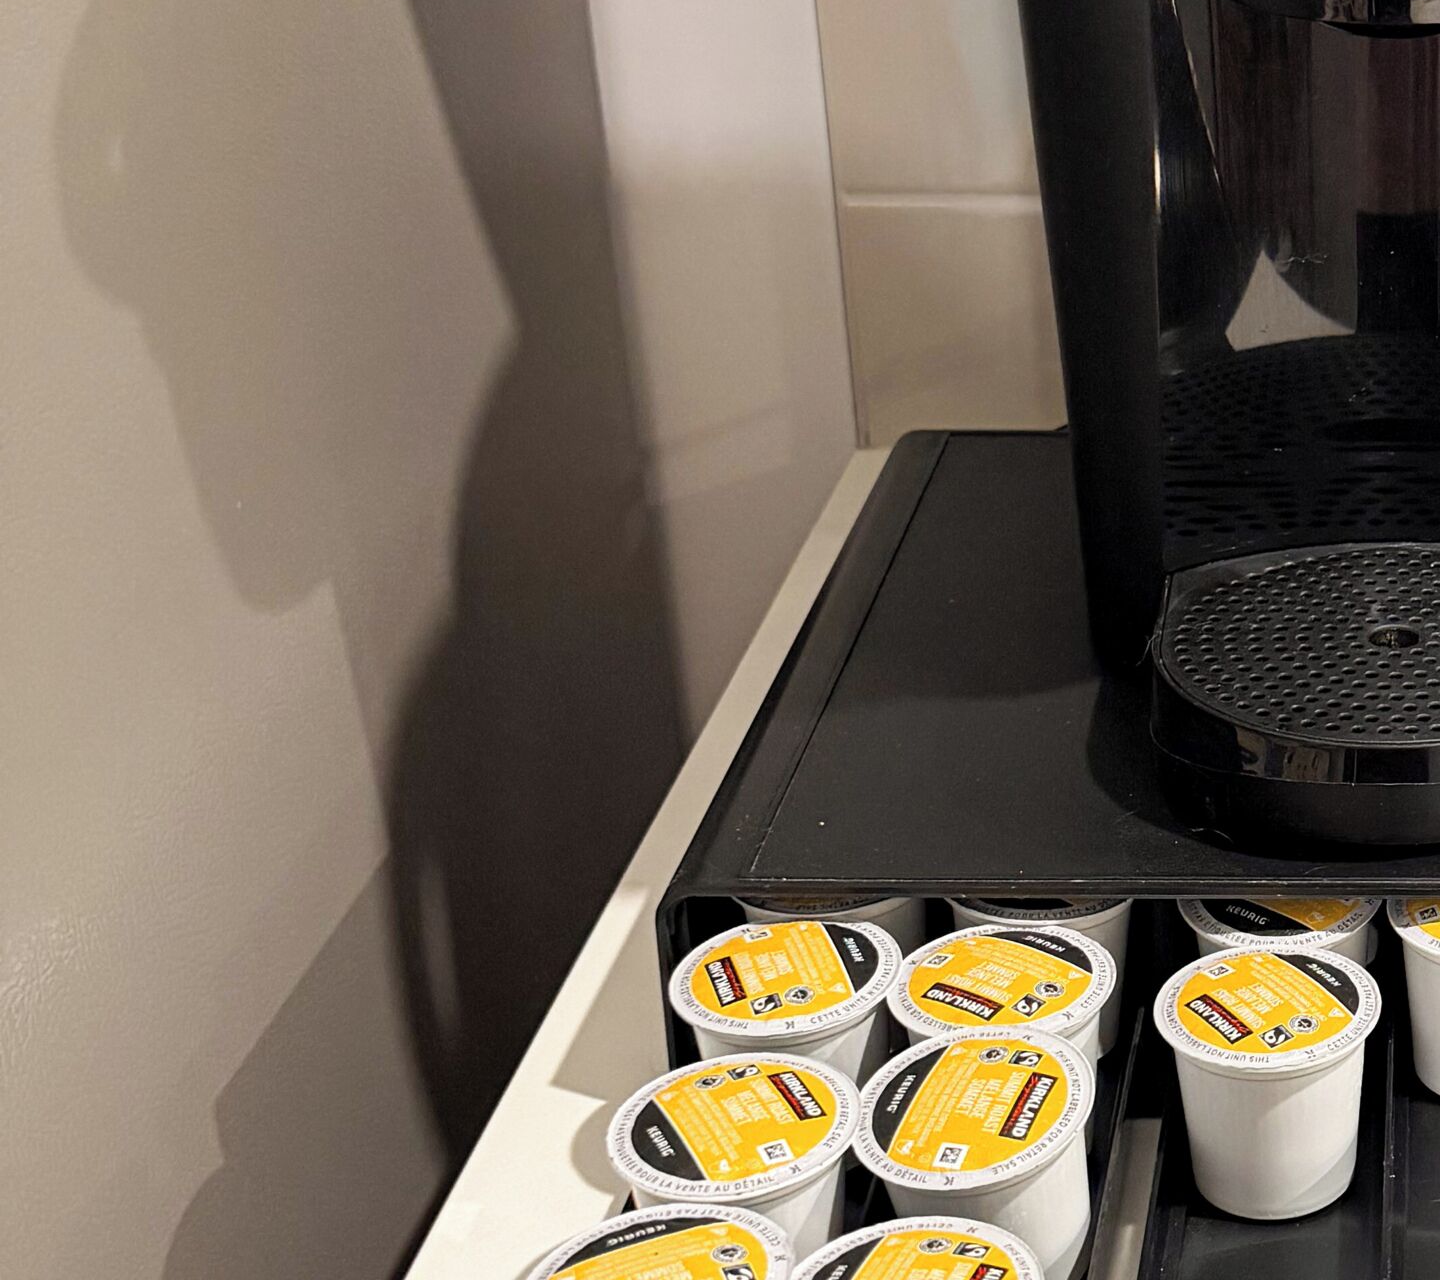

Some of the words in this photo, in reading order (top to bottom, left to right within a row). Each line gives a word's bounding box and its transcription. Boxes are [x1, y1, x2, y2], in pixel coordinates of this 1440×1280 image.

[1225, 904, 1267, 925] KEURIG
[1022, 935, 1066, 953] KEURIG
[707, 961, 736, 1005] KIRKLAND
[1306, 963, 1342, 987] KEURIG
[926, 988, 996, 1018] KIRKLAND
[810, 1009, 841, 1024] CETTE
[1189, 999, 1242, 1041] KIRKLAND
[1206, 1048, 1225, 1057] NOT
[1327, 1033, 1352, 1050] CETTE
[778, 1069, 822, 1118] KIRKLAND
[887, 1074, 917, 1114] KEURIG
[995, 1070, 1026, 1105] SUMMIT
[980, 1103, 1007, 1135] ROAST
[1010, 1076, 1054, 1139] KIRKLAND
[1059, 1093, 1079, 1127] LABELLED
[646, 1125, 675, 1158] KEURIG
[1046, 1128, 1062, 1142] FOR
[1017, 1143, 1047, 1161] RETAIL
[881, 1163, 894, 1172] AU
[894, 1169, 926, 1183] DÉTAIL
[991, 1160, 1016, 1175] SALE
[635, 1168, 659, 1183] POUR
[659, 1179, 672, 1187] LA
[675, 1184, 709, 1192] VENTE
[714, 1184, 729, 1192] AU
[734, 1177, 774, 1190] DÉTAIL
[605, 1223, 667, 1247] KEURIG
